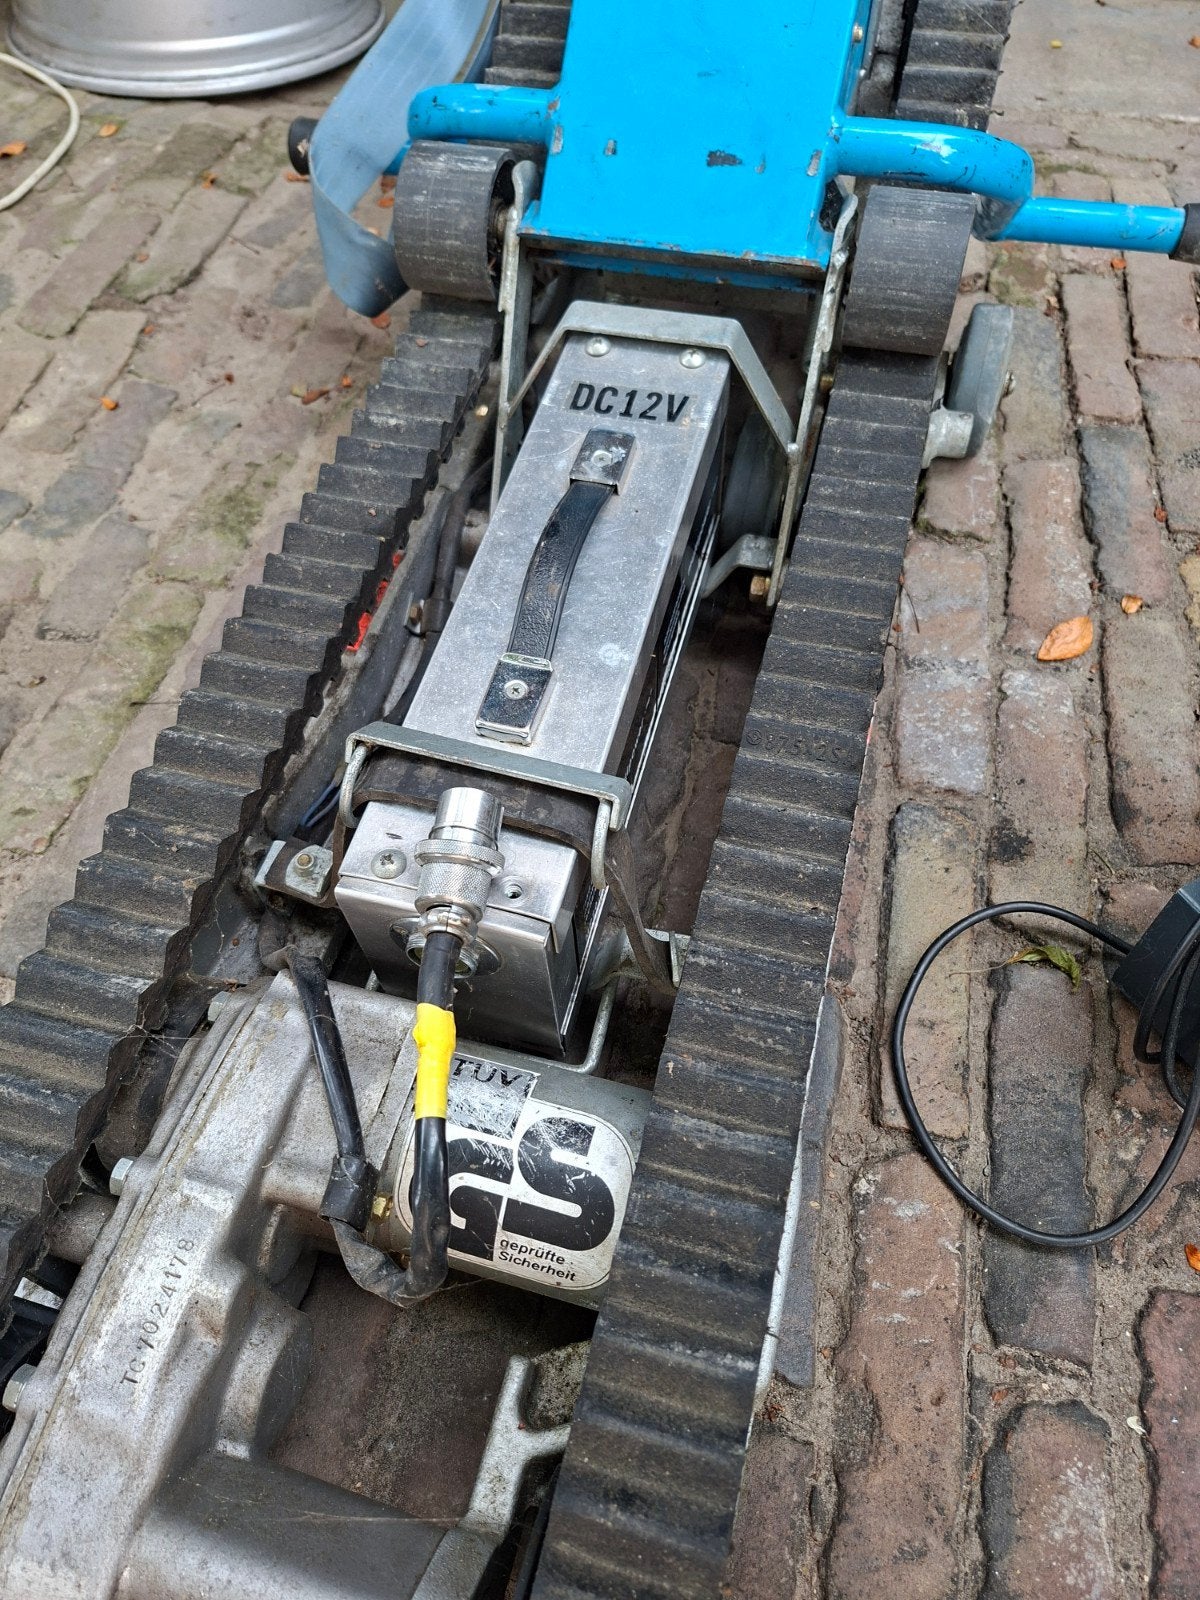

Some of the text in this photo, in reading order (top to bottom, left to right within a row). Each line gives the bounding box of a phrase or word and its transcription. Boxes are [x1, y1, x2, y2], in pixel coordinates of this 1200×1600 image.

[569, 383, 690, 423] DC12V
[498, 1250, 577, 1283] Sicherheit
[500, 1237, 566, 1266] geprüfte
